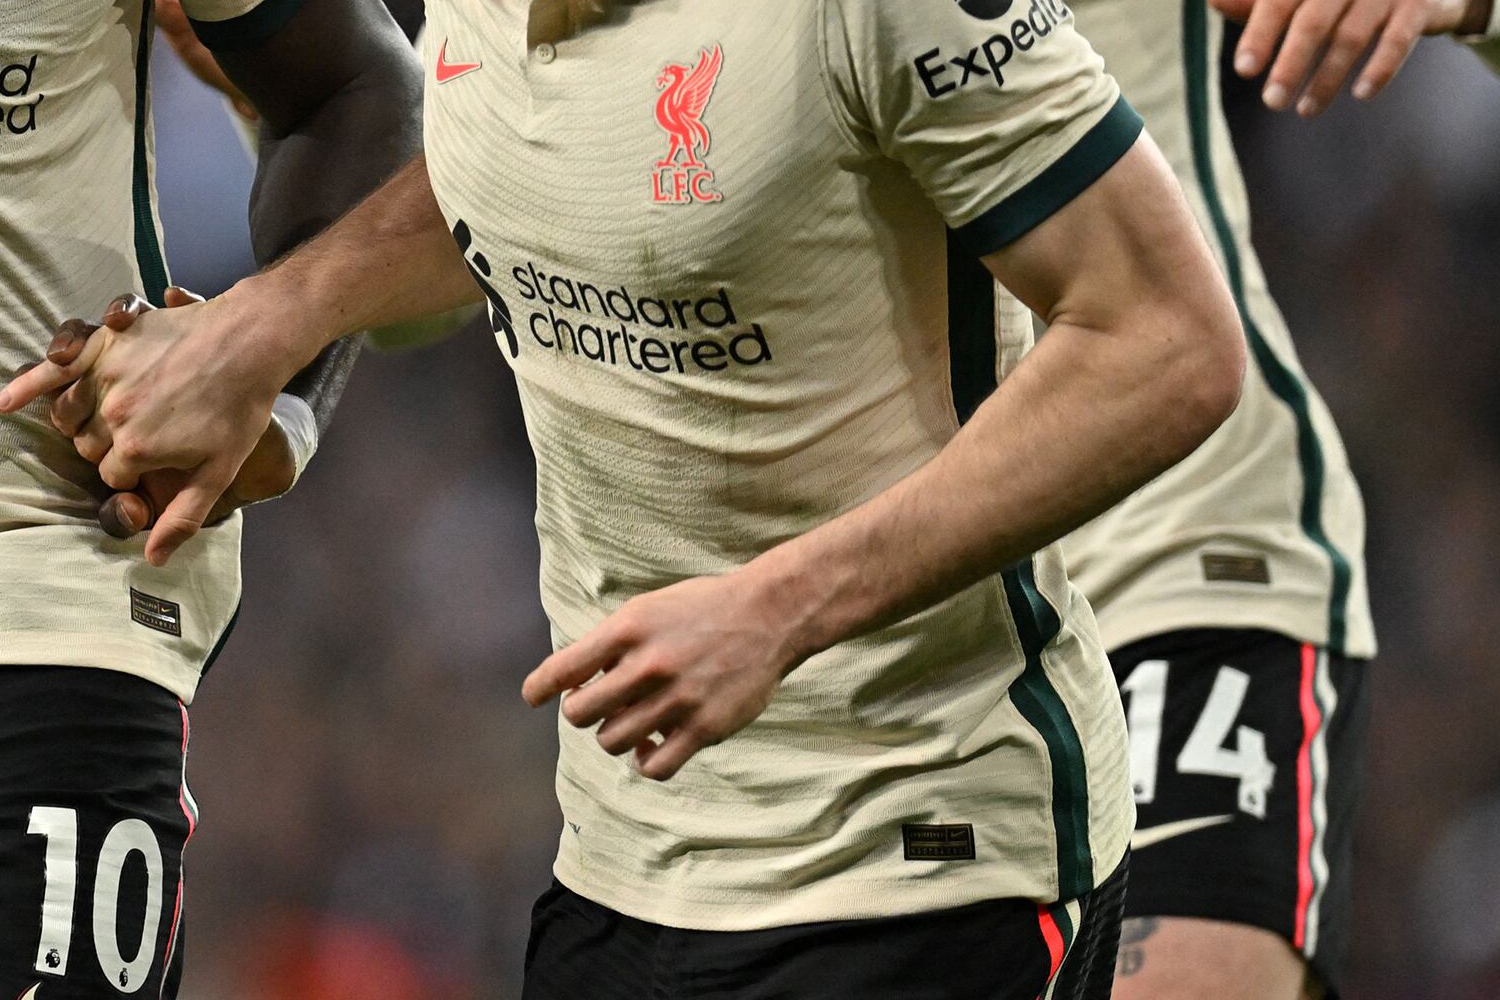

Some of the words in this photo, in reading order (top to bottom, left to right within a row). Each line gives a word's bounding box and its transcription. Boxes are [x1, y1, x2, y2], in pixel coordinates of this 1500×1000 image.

[512, 261, 737, 330] standard
[529, 306, 772, 374] chartered
[1119, 659, 1277, 820] 14
[26, 805, 164, 994] 10
